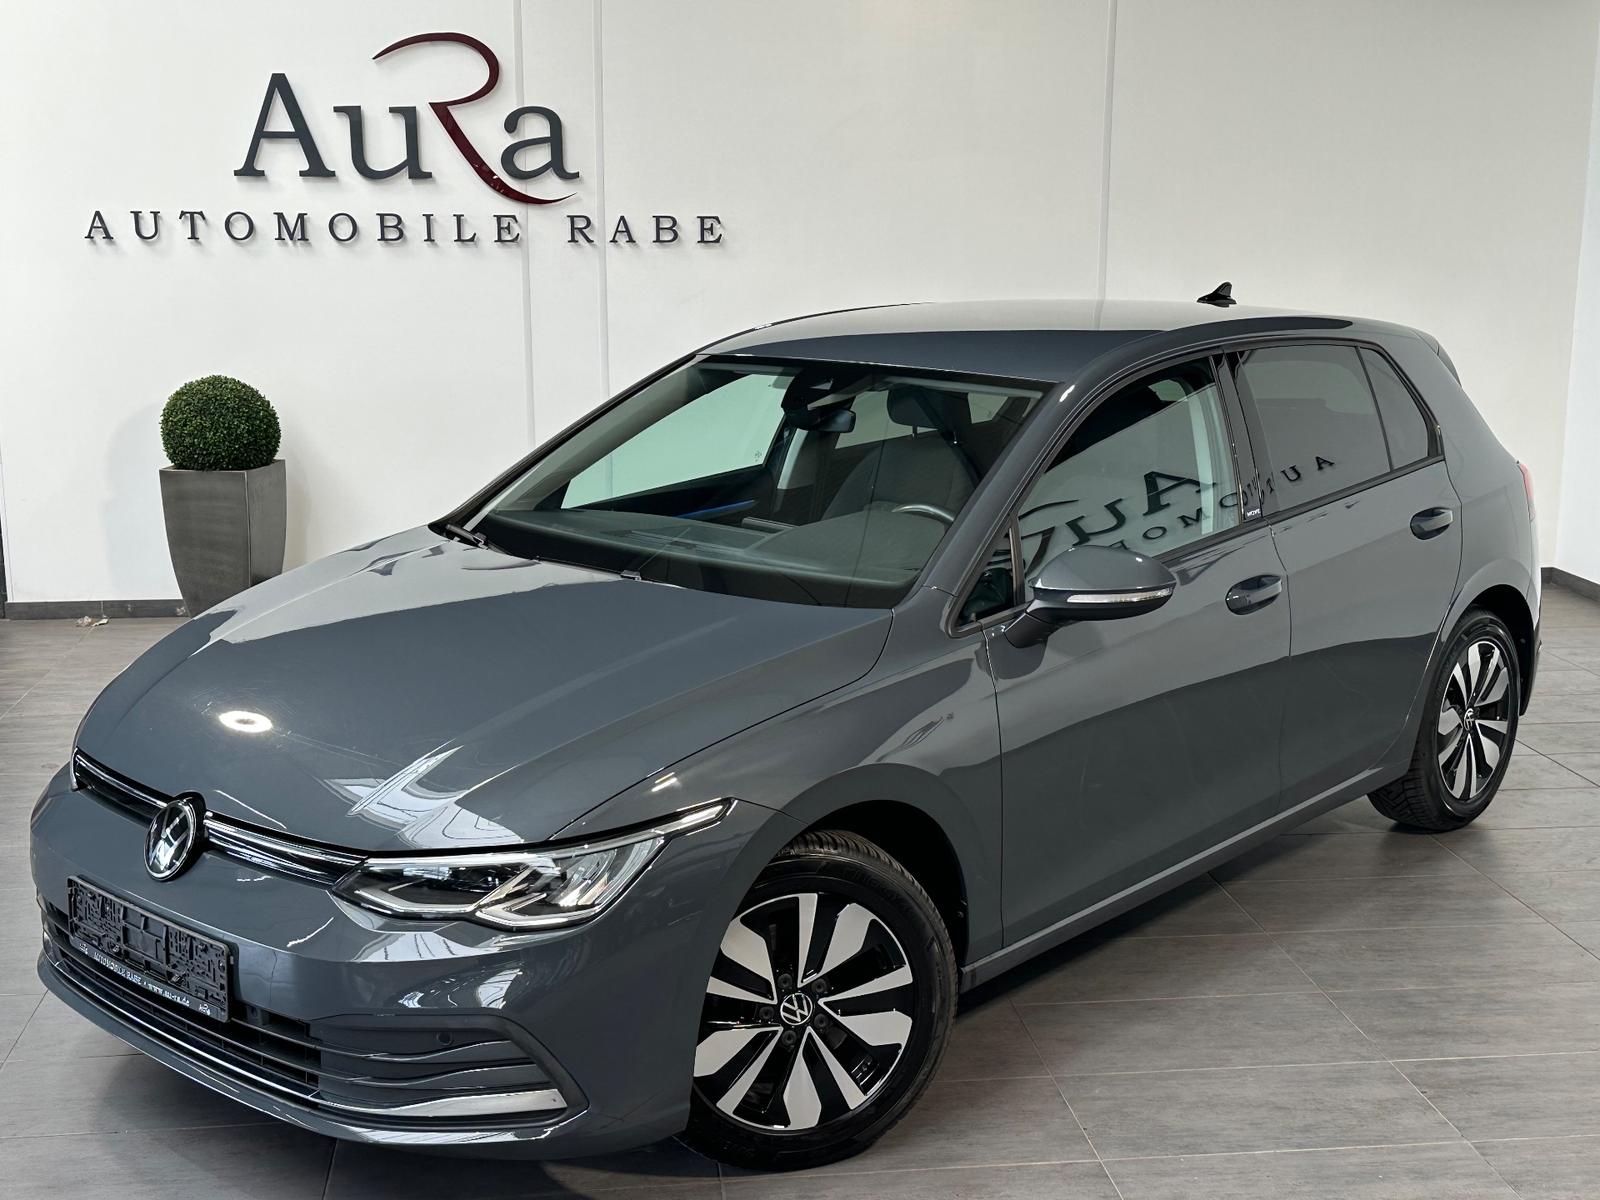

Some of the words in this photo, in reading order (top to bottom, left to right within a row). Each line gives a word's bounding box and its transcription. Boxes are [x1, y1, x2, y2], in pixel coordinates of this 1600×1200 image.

[234, 32, 580, 205] AuRa
[85, 210, 522, 244] AUTOMOBILE
[567, 214, 724, 244] RABE
